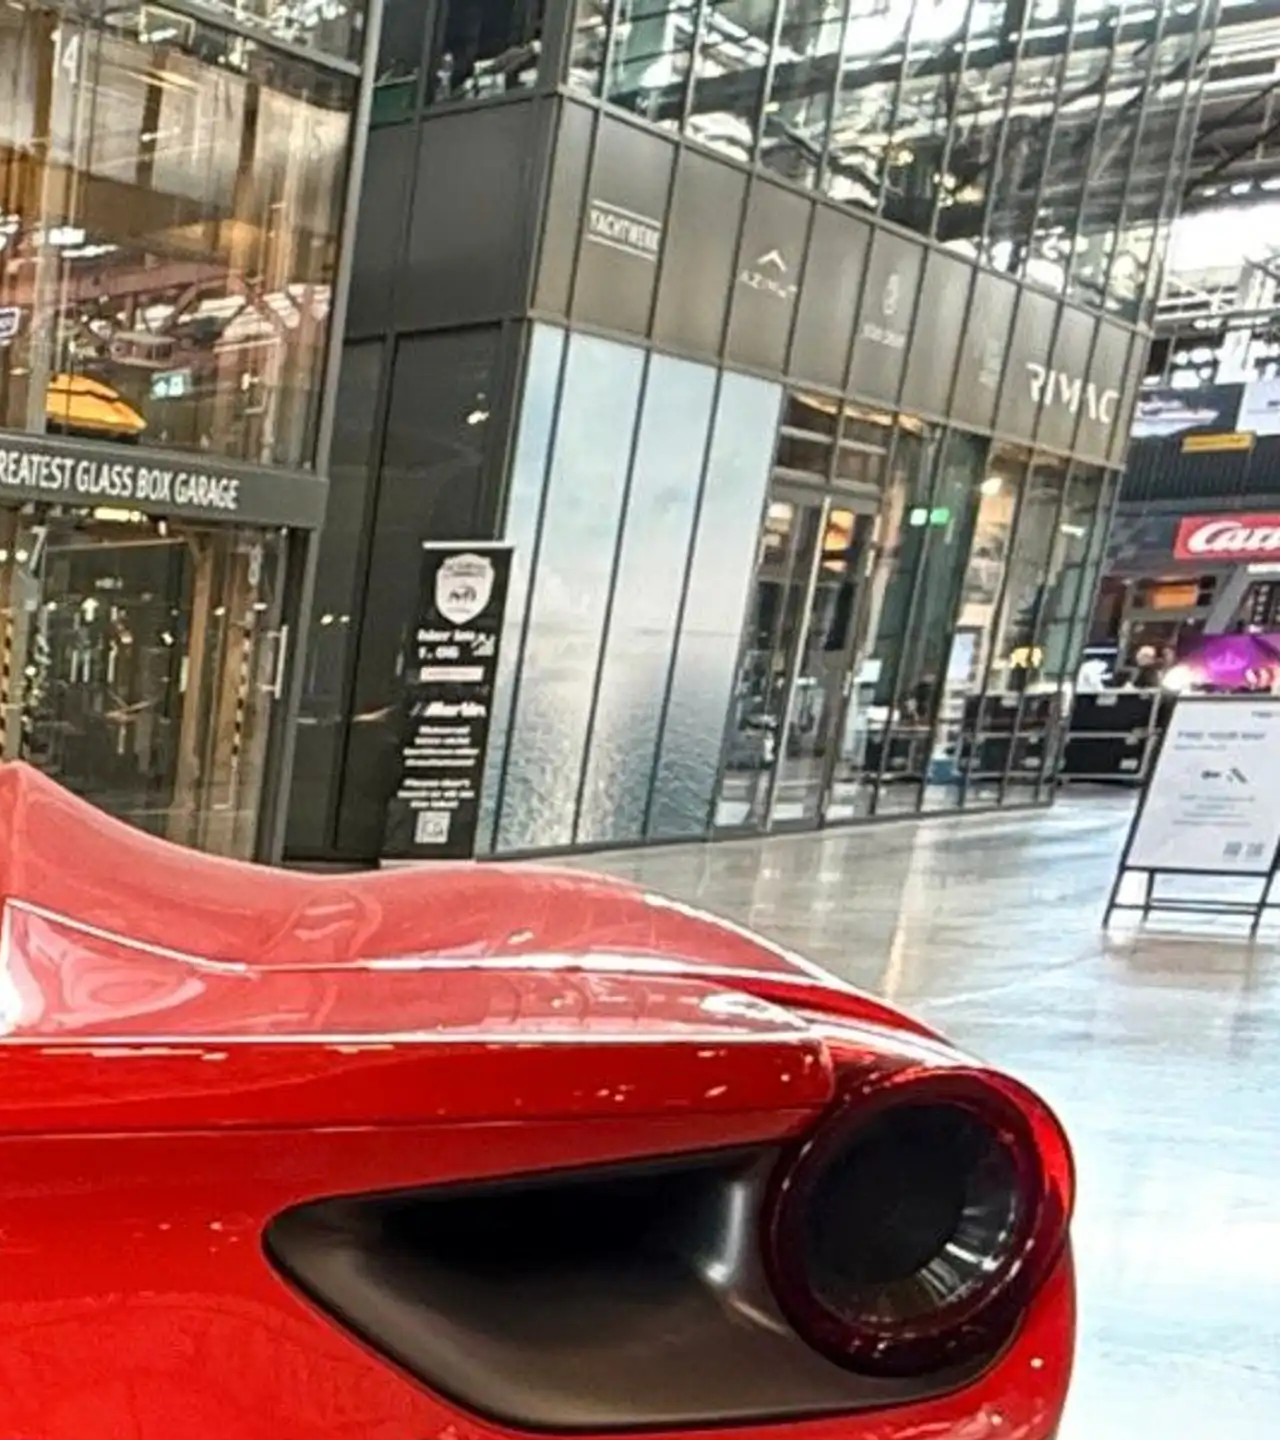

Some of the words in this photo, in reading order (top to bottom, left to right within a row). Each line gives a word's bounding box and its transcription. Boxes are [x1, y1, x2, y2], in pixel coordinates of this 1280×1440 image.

[50, 27, 79, 84] 14
[75, 460, 132, 497] GLASS
[136, 468, 174, 501] BOX
[174, 472, 241, 510] GARAGE
